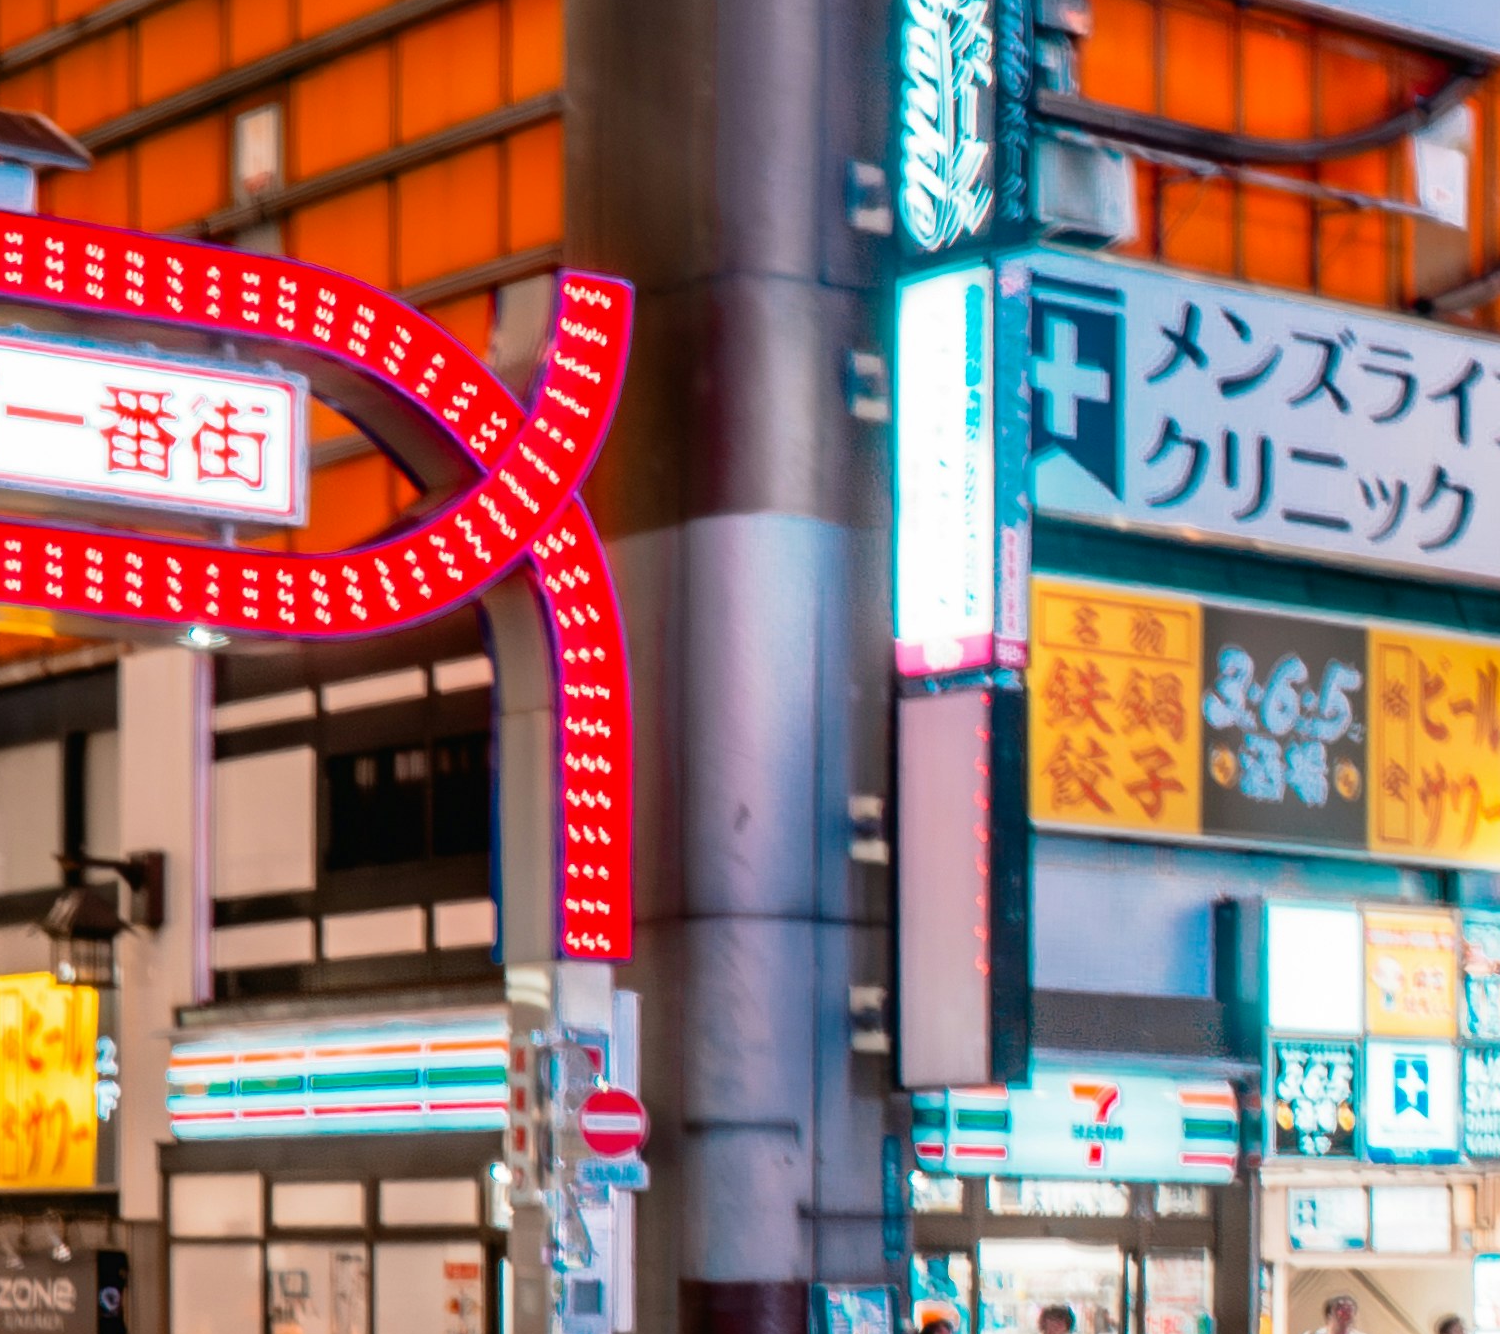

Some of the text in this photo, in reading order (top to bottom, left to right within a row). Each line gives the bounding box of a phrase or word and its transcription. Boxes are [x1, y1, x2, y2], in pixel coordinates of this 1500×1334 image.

[1142, 414, 1477, 552] クリニック
